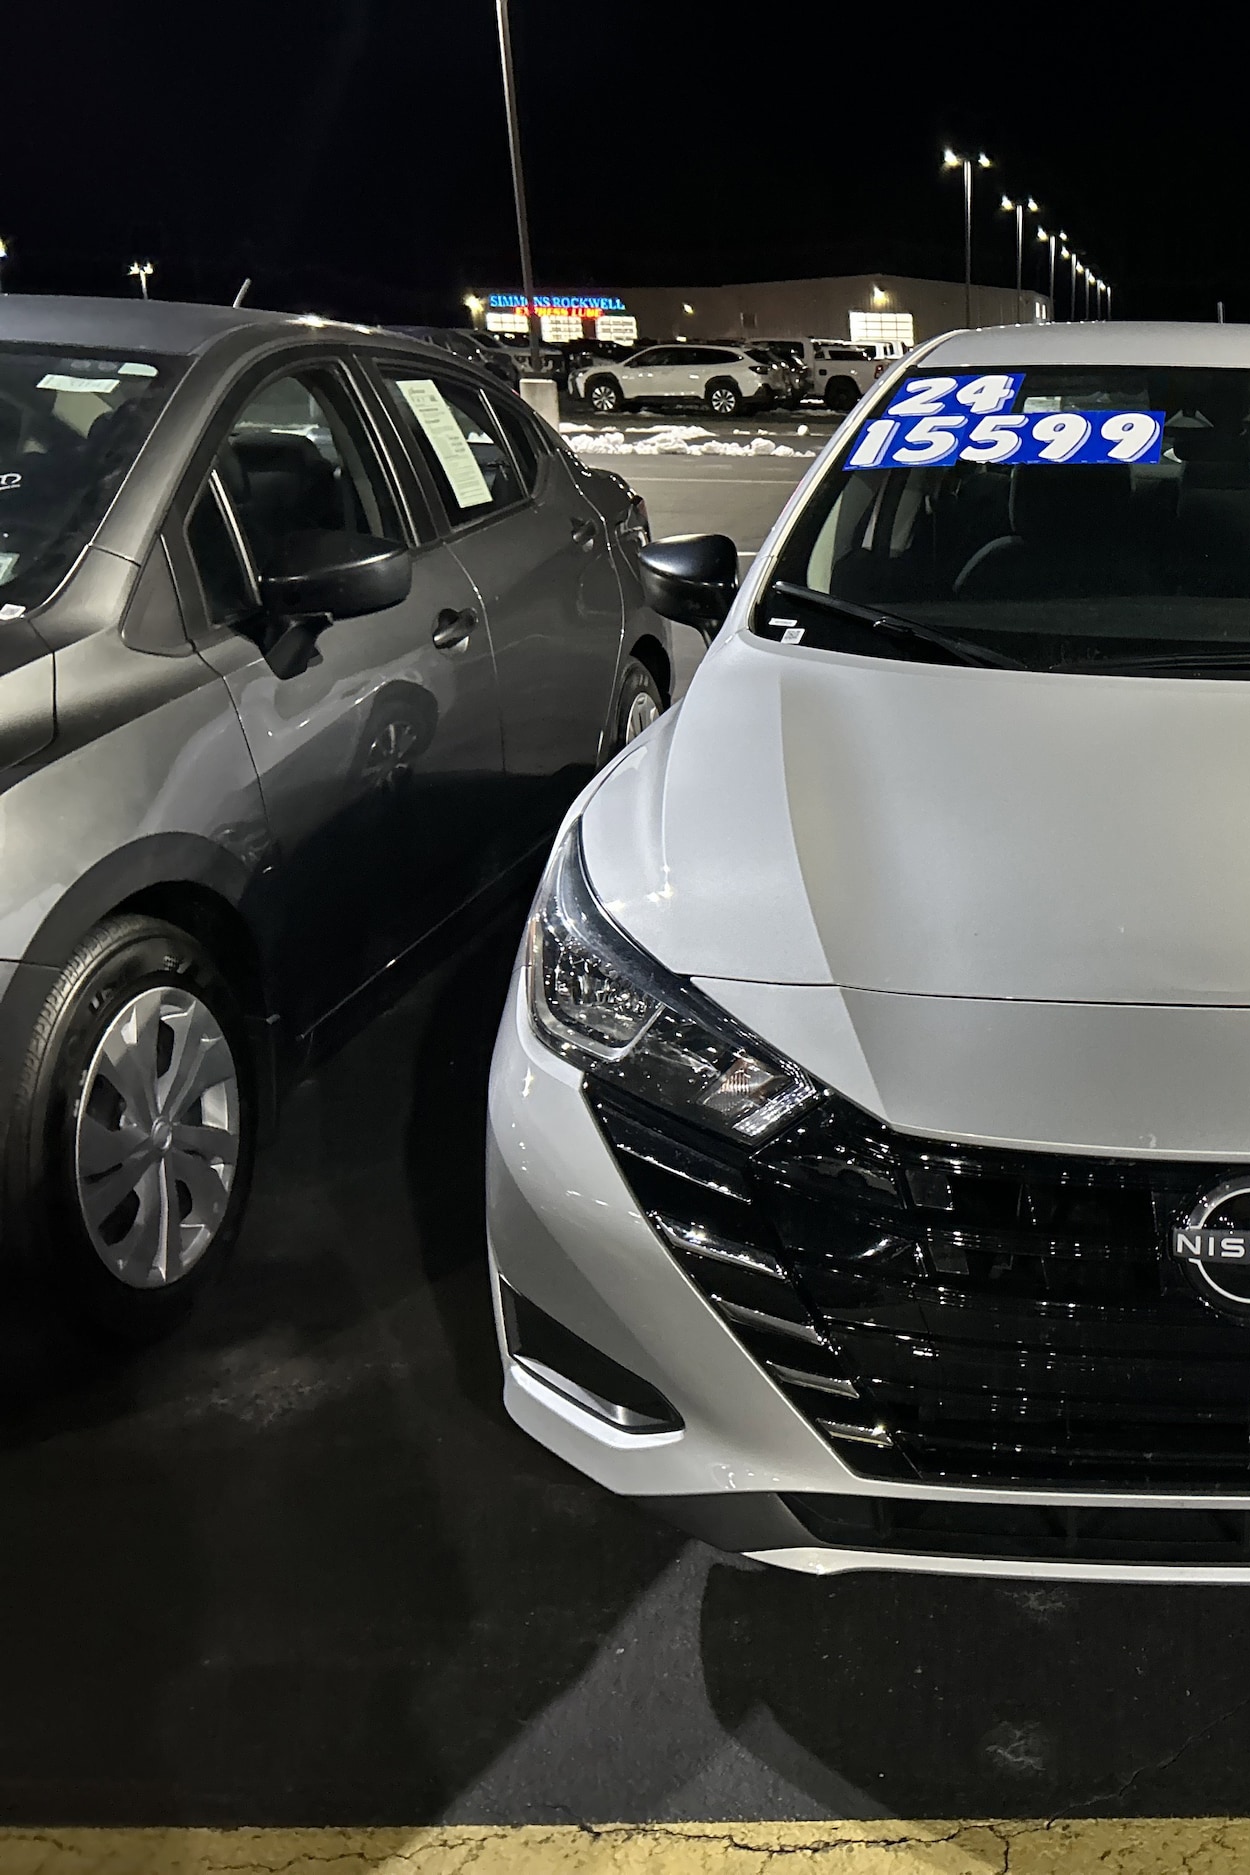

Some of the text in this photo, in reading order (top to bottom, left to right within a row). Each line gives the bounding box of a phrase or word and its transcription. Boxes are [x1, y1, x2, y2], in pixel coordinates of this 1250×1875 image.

[552, 296, 625, 310] ROCKWELL
[887, 375, 1015, 416] 24
[849, 412, 1161, 467] 15599
